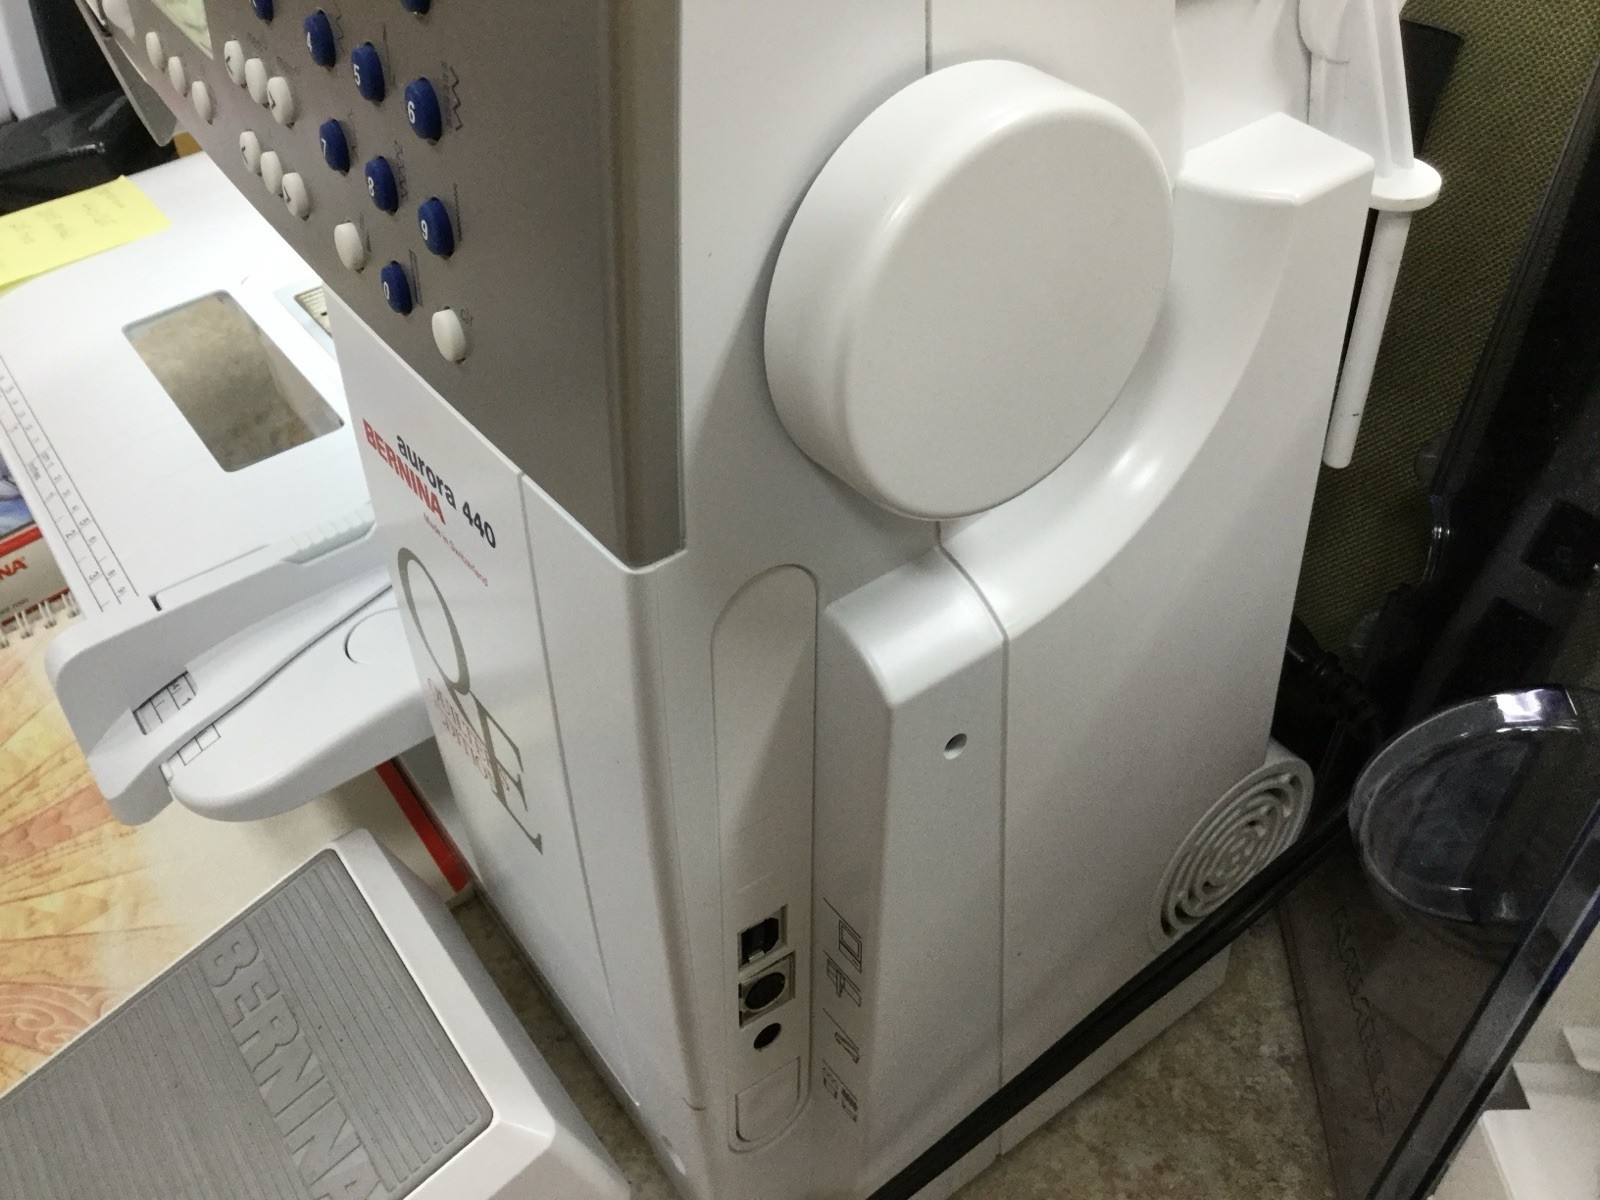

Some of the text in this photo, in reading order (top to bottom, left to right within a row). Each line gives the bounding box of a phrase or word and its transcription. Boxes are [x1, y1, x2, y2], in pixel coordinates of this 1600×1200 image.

[353, 63, 361, 86] 5
[407, 100, 416, 124] 6
[321, 137, 327, 156] 7
[367, 176, 375, 197] 8
[421, 219, 428, 241] 9
[362, 417, 446, 525] BERNINA
[396, 434, 496, 549] aurora 440
